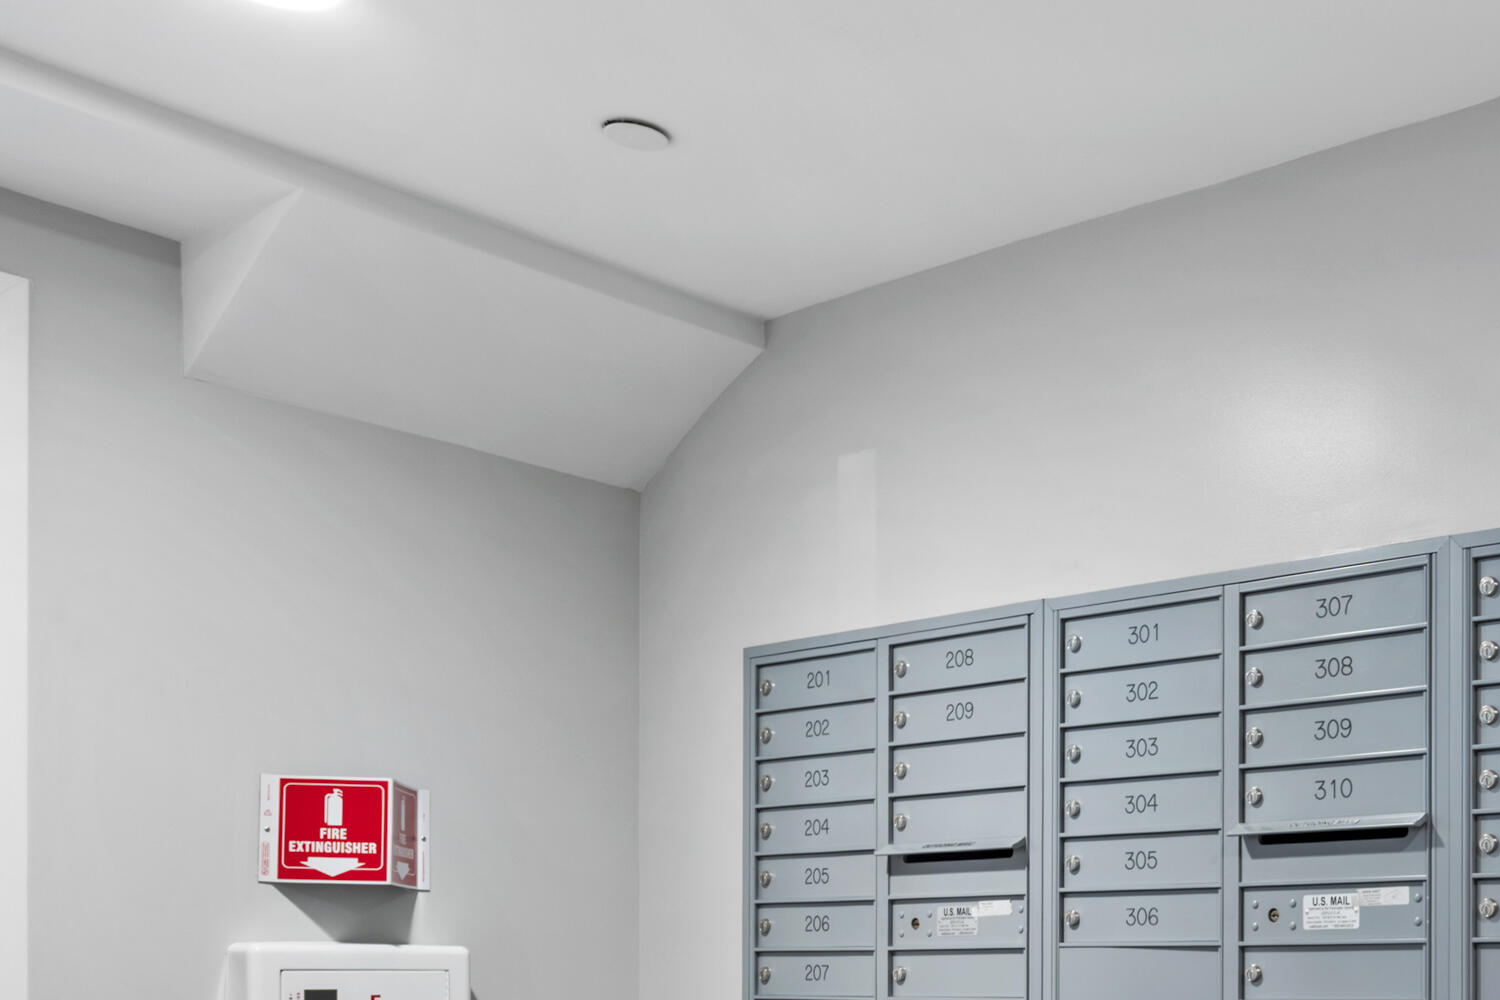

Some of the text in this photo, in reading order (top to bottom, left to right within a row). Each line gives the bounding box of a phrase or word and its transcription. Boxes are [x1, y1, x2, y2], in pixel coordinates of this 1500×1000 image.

[1315, 594, 1353, 619] 307
[1127, 623, 1159, 646] 301
[945, 647, 975, 670] 208
[1314, 655, 1354, 680] 308
[805, 669, 831, 690] 201
[1125, 680, 1159, 703] 302
[945, 701, 975, 722] 209
[805, 718, 830, 738] 202
[1313, 717, 1353, 741] 309
[1125, 736, 1159, 759] 303
[804, 769, 830, 788] 203
[1314, 777, 1353, 801] 310
[1124, 793, 1159, 815] 304
[320, 827, 347, 840] FIRE
[804, 818, 830, 837] 204
[288, 840, 377, 854] EXTINGUISHER
[1124, 850, 1158, 871] 305
[804, 867, 830, 886] 205
[957, 907, 971, 916] MAIL
[1312, 896, 1328, 906] U.S.
[1330, 896, 1350, 905] MAIL
[804, 914, 830, 933] 206
[1125, 906, 1159, 927] 306
[804, 963, 830, 982] 207
